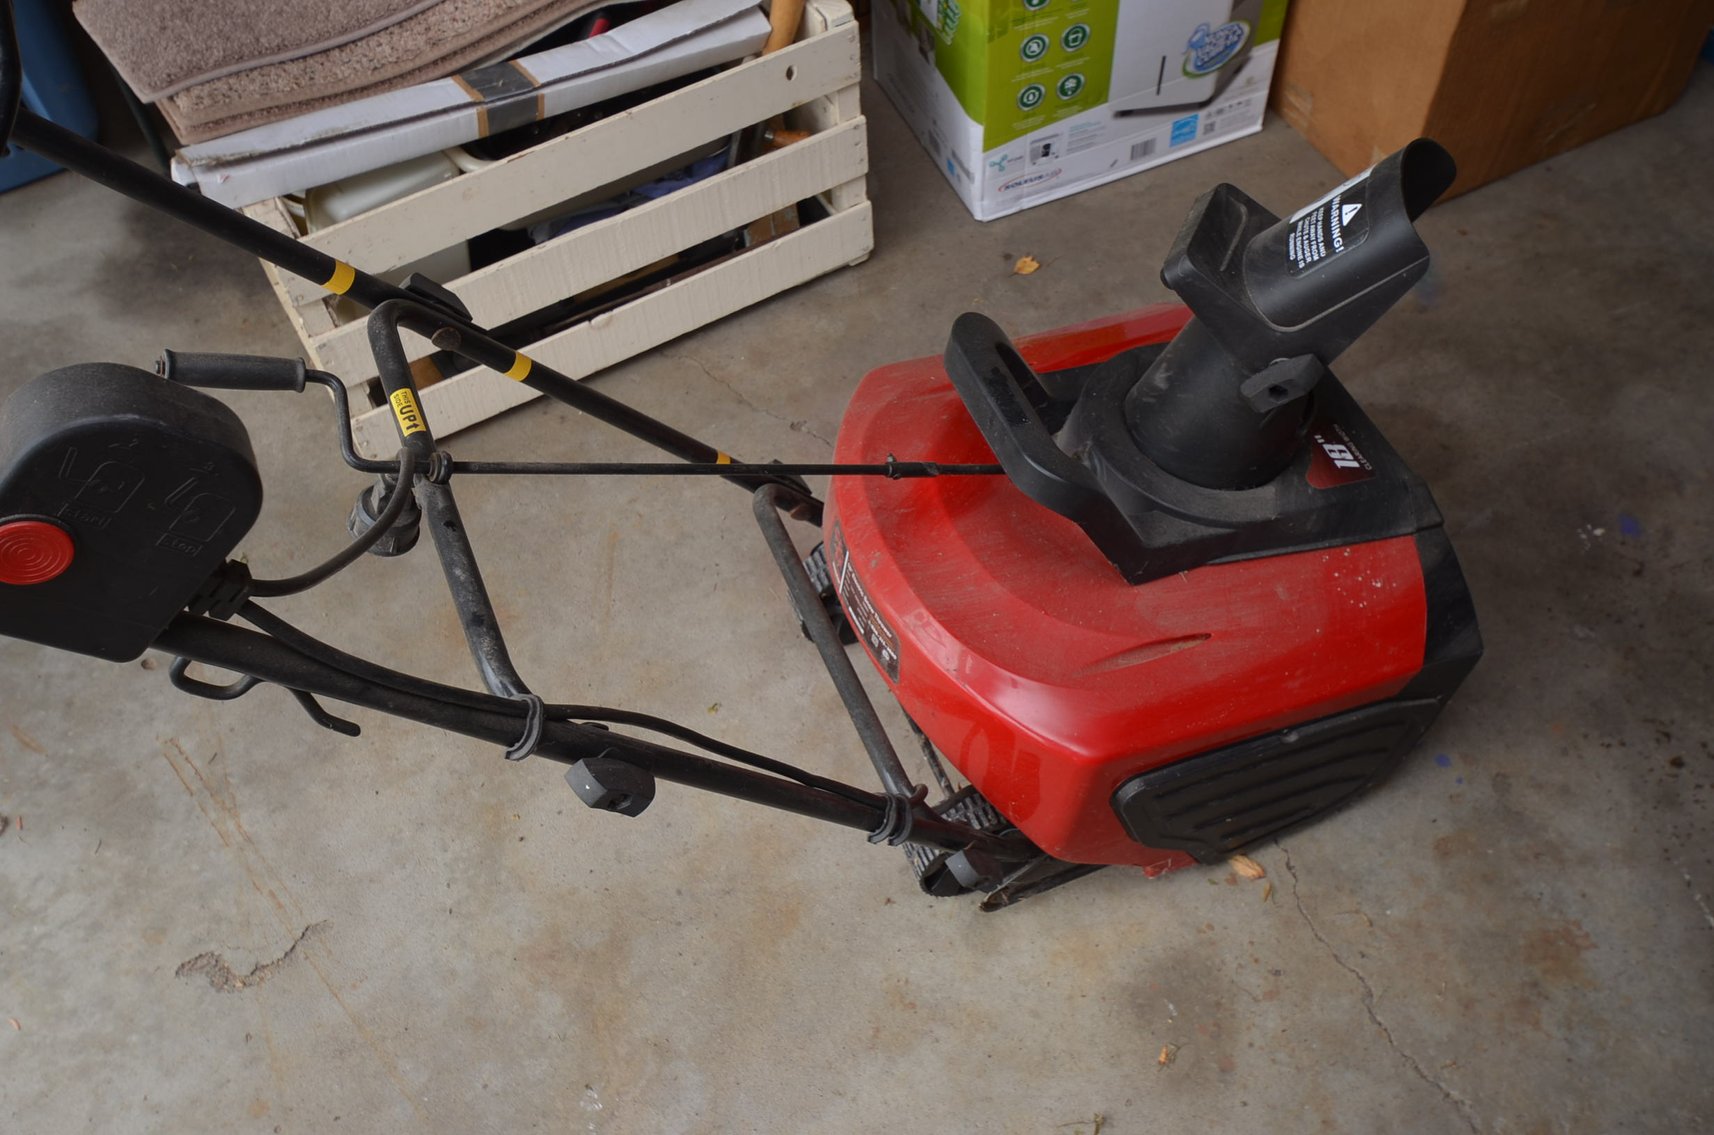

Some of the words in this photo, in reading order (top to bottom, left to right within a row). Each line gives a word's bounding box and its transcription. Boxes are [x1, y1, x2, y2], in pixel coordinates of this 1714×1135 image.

[1330, 194, 1345, 253] WARNING!
[1295, 237, 1304, 261] ENGINE
[1303, 240, 1312, 264] AUGER
[1310, 241, 1320, 261] FROM
[1318, 242, 1326, 258] AND
[1298, 260, 1306, 269] IS
[394, 393, 404, 407] SIDE
[401, 391, 411, 404] THIS
[400, 404, 417, 422] UP
